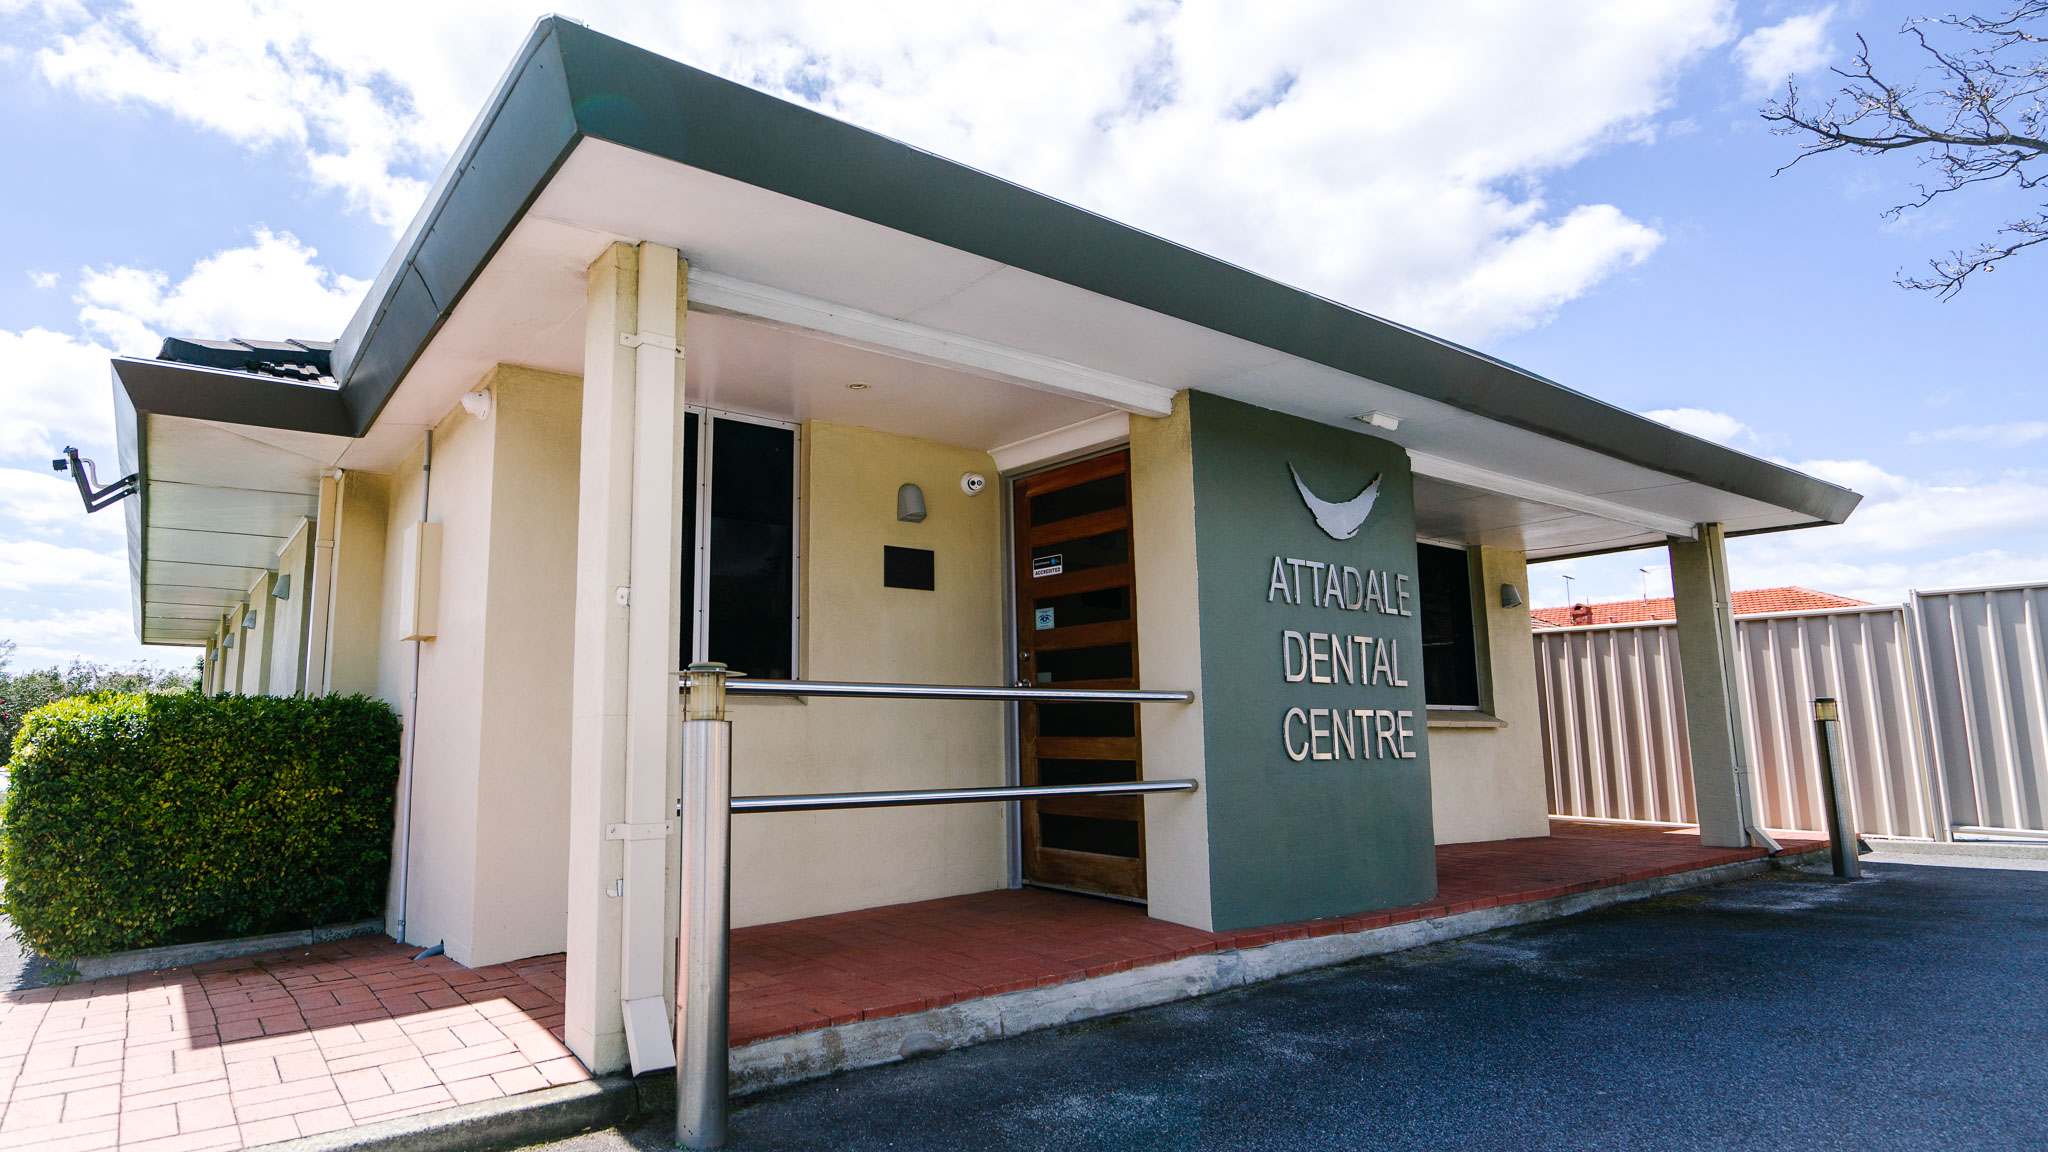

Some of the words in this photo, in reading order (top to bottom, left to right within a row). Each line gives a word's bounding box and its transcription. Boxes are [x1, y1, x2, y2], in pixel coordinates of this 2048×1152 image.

[1035, 567, 1061, 576] ACCREDITED
[1267, 556, 1412, 617] ATTADALE
[1283, 630, 1408, 687] DENTAL
[1283, 707, 1417, 761] CENTRE
